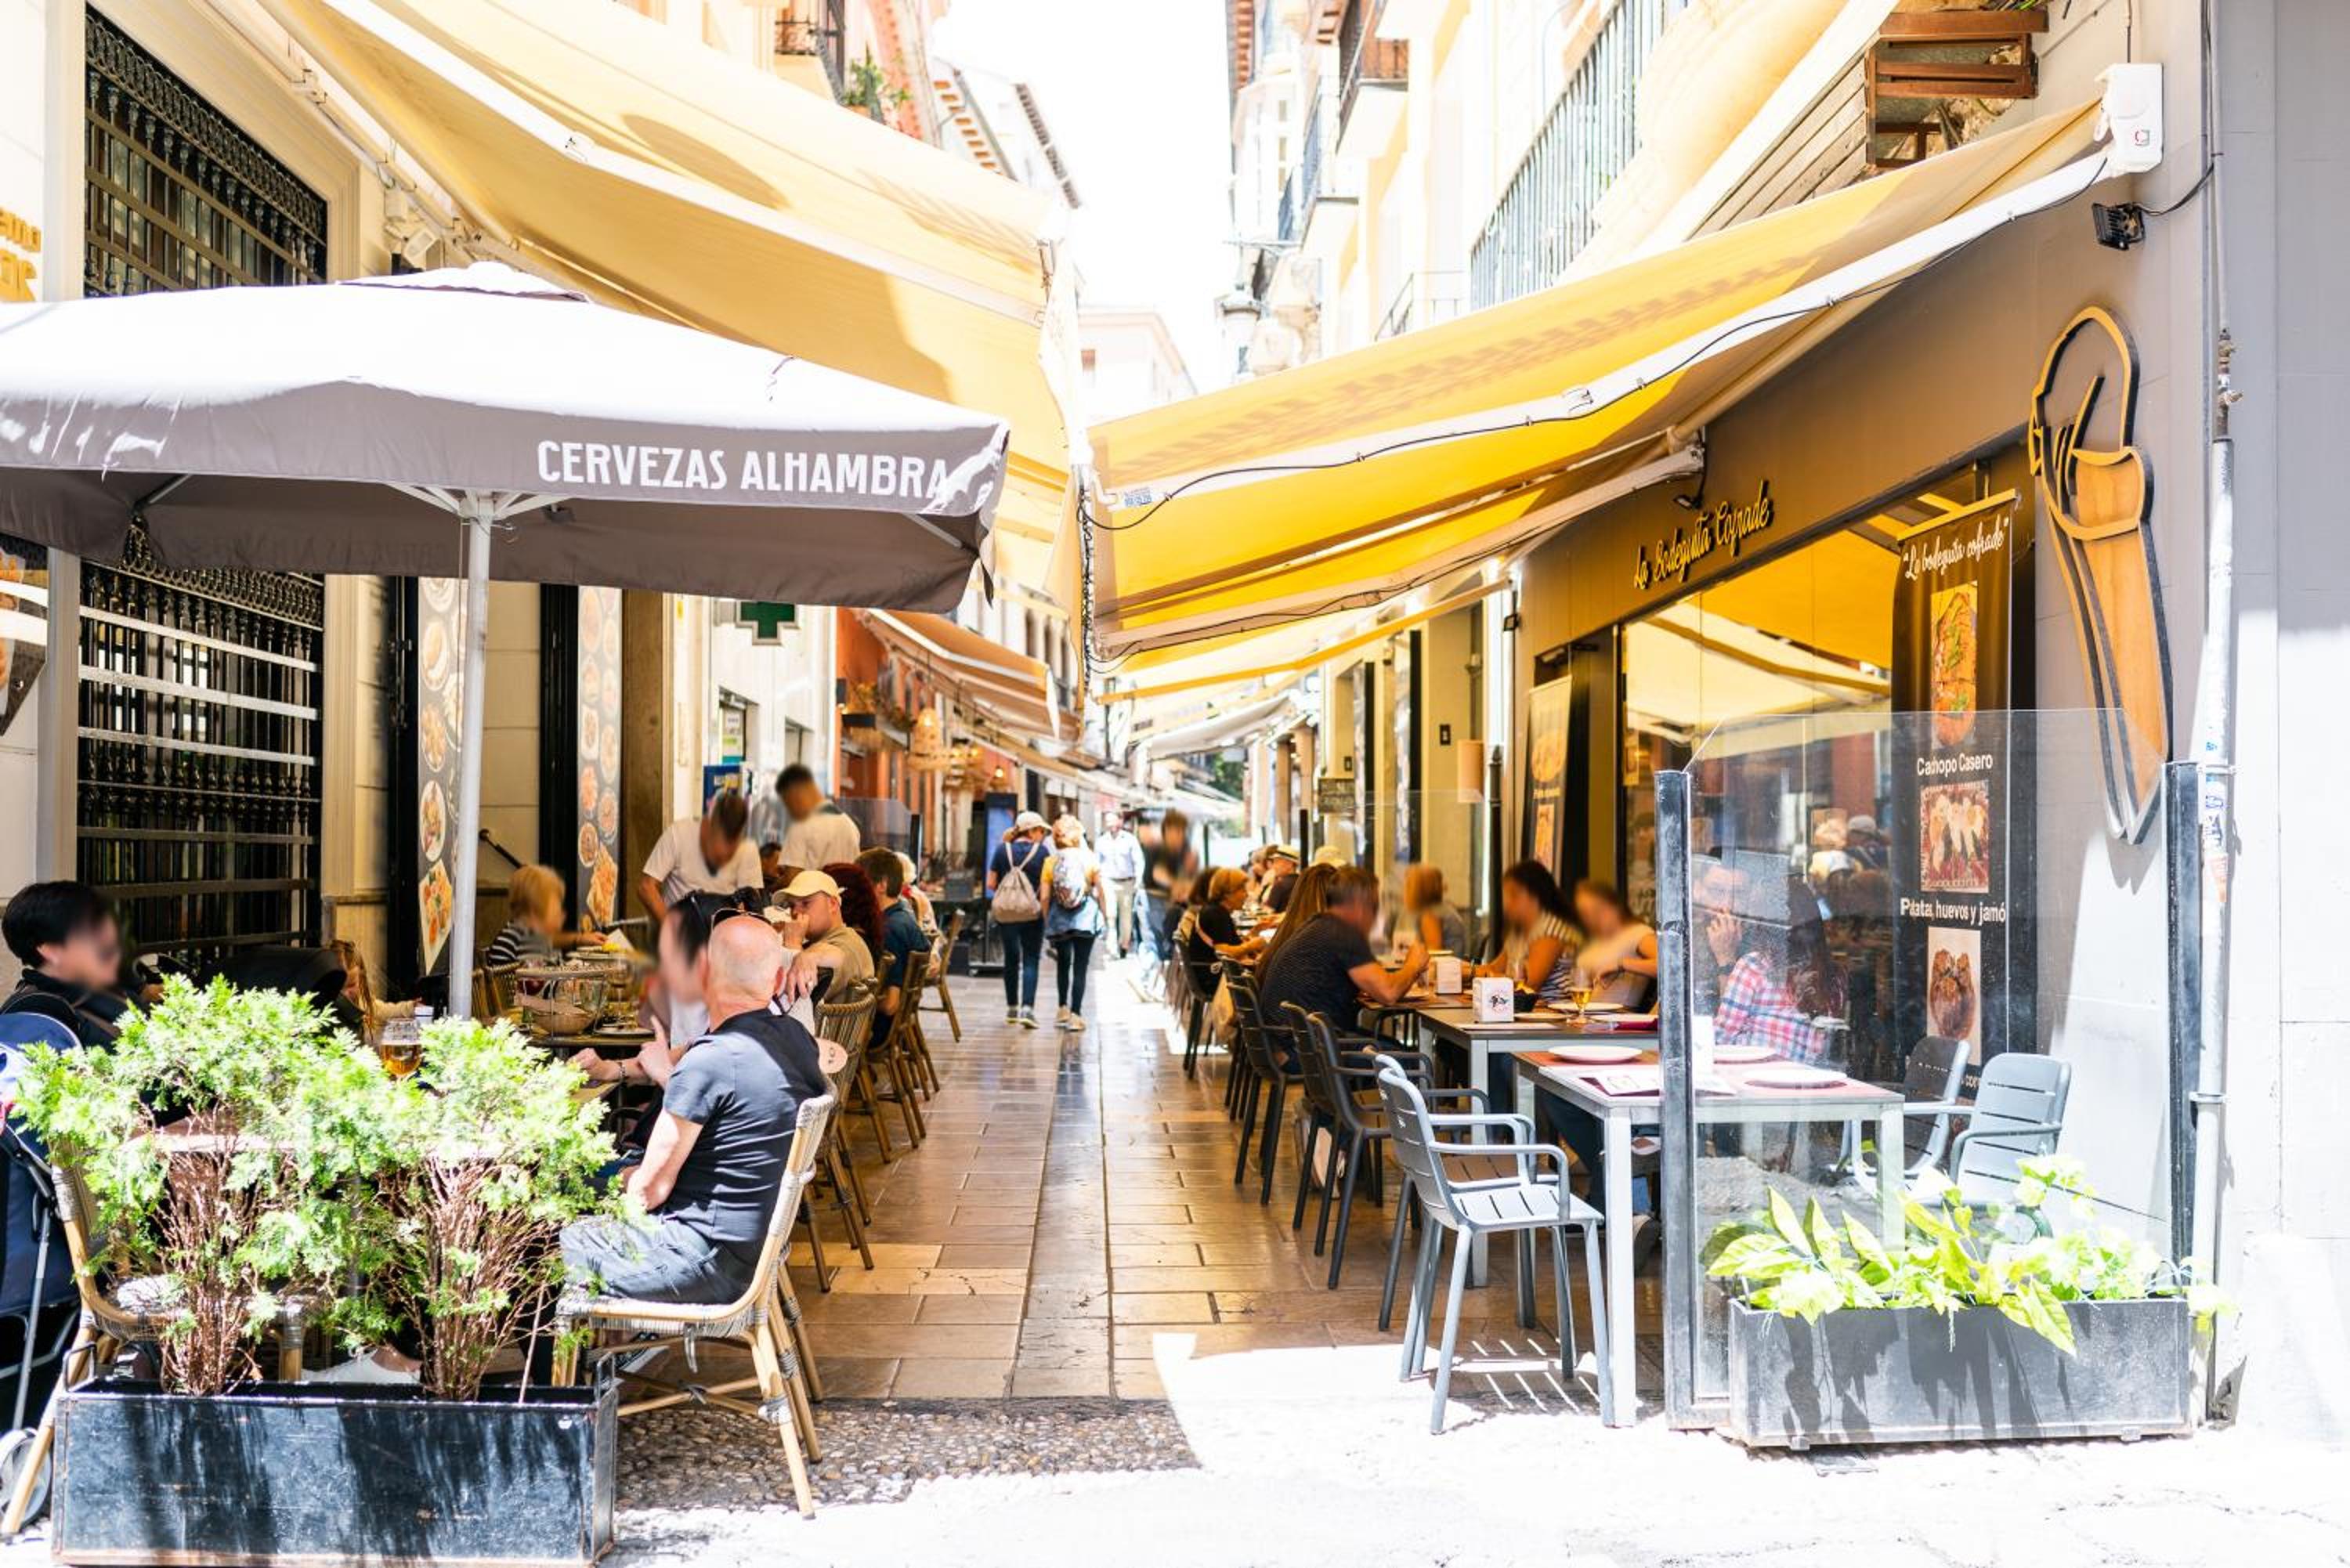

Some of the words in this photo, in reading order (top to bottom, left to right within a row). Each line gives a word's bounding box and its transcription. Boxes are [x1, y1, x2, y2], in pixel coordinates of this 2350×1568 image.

[537, 440, 727, 490] CERVEZAS
[740, 450, 946, 498] ALHAMBRA
[1958, 753, 1994, 771] Casero
[1970, 905, 1977, 926] y
